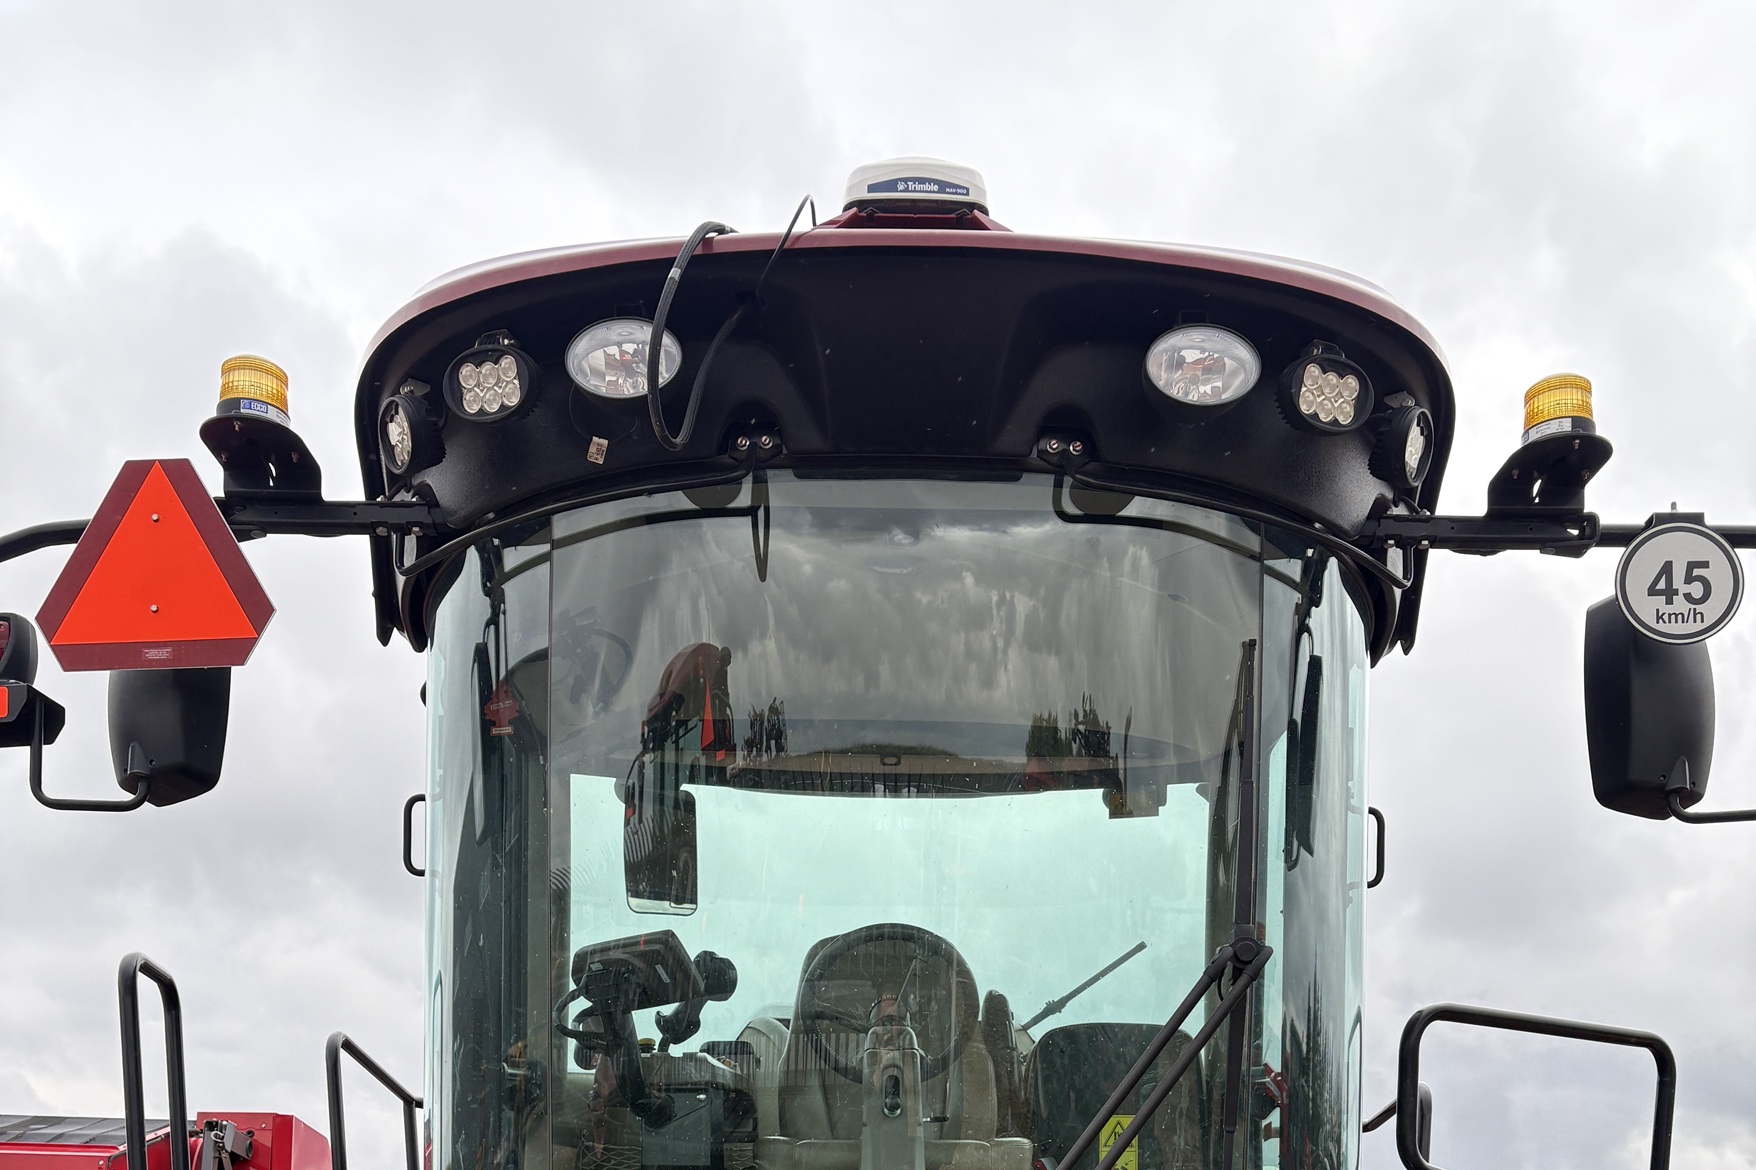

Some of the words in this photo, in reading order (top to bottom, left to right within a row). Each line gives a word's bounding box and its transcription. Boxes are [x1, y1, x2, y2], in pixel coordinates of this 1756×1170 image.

[907, 181, 939, 192] Trimble
[251, 402, 267, 413] ECCO
[1647, 560, 1712, 606] 45
[1655, 607, 1705, 624] km/h
